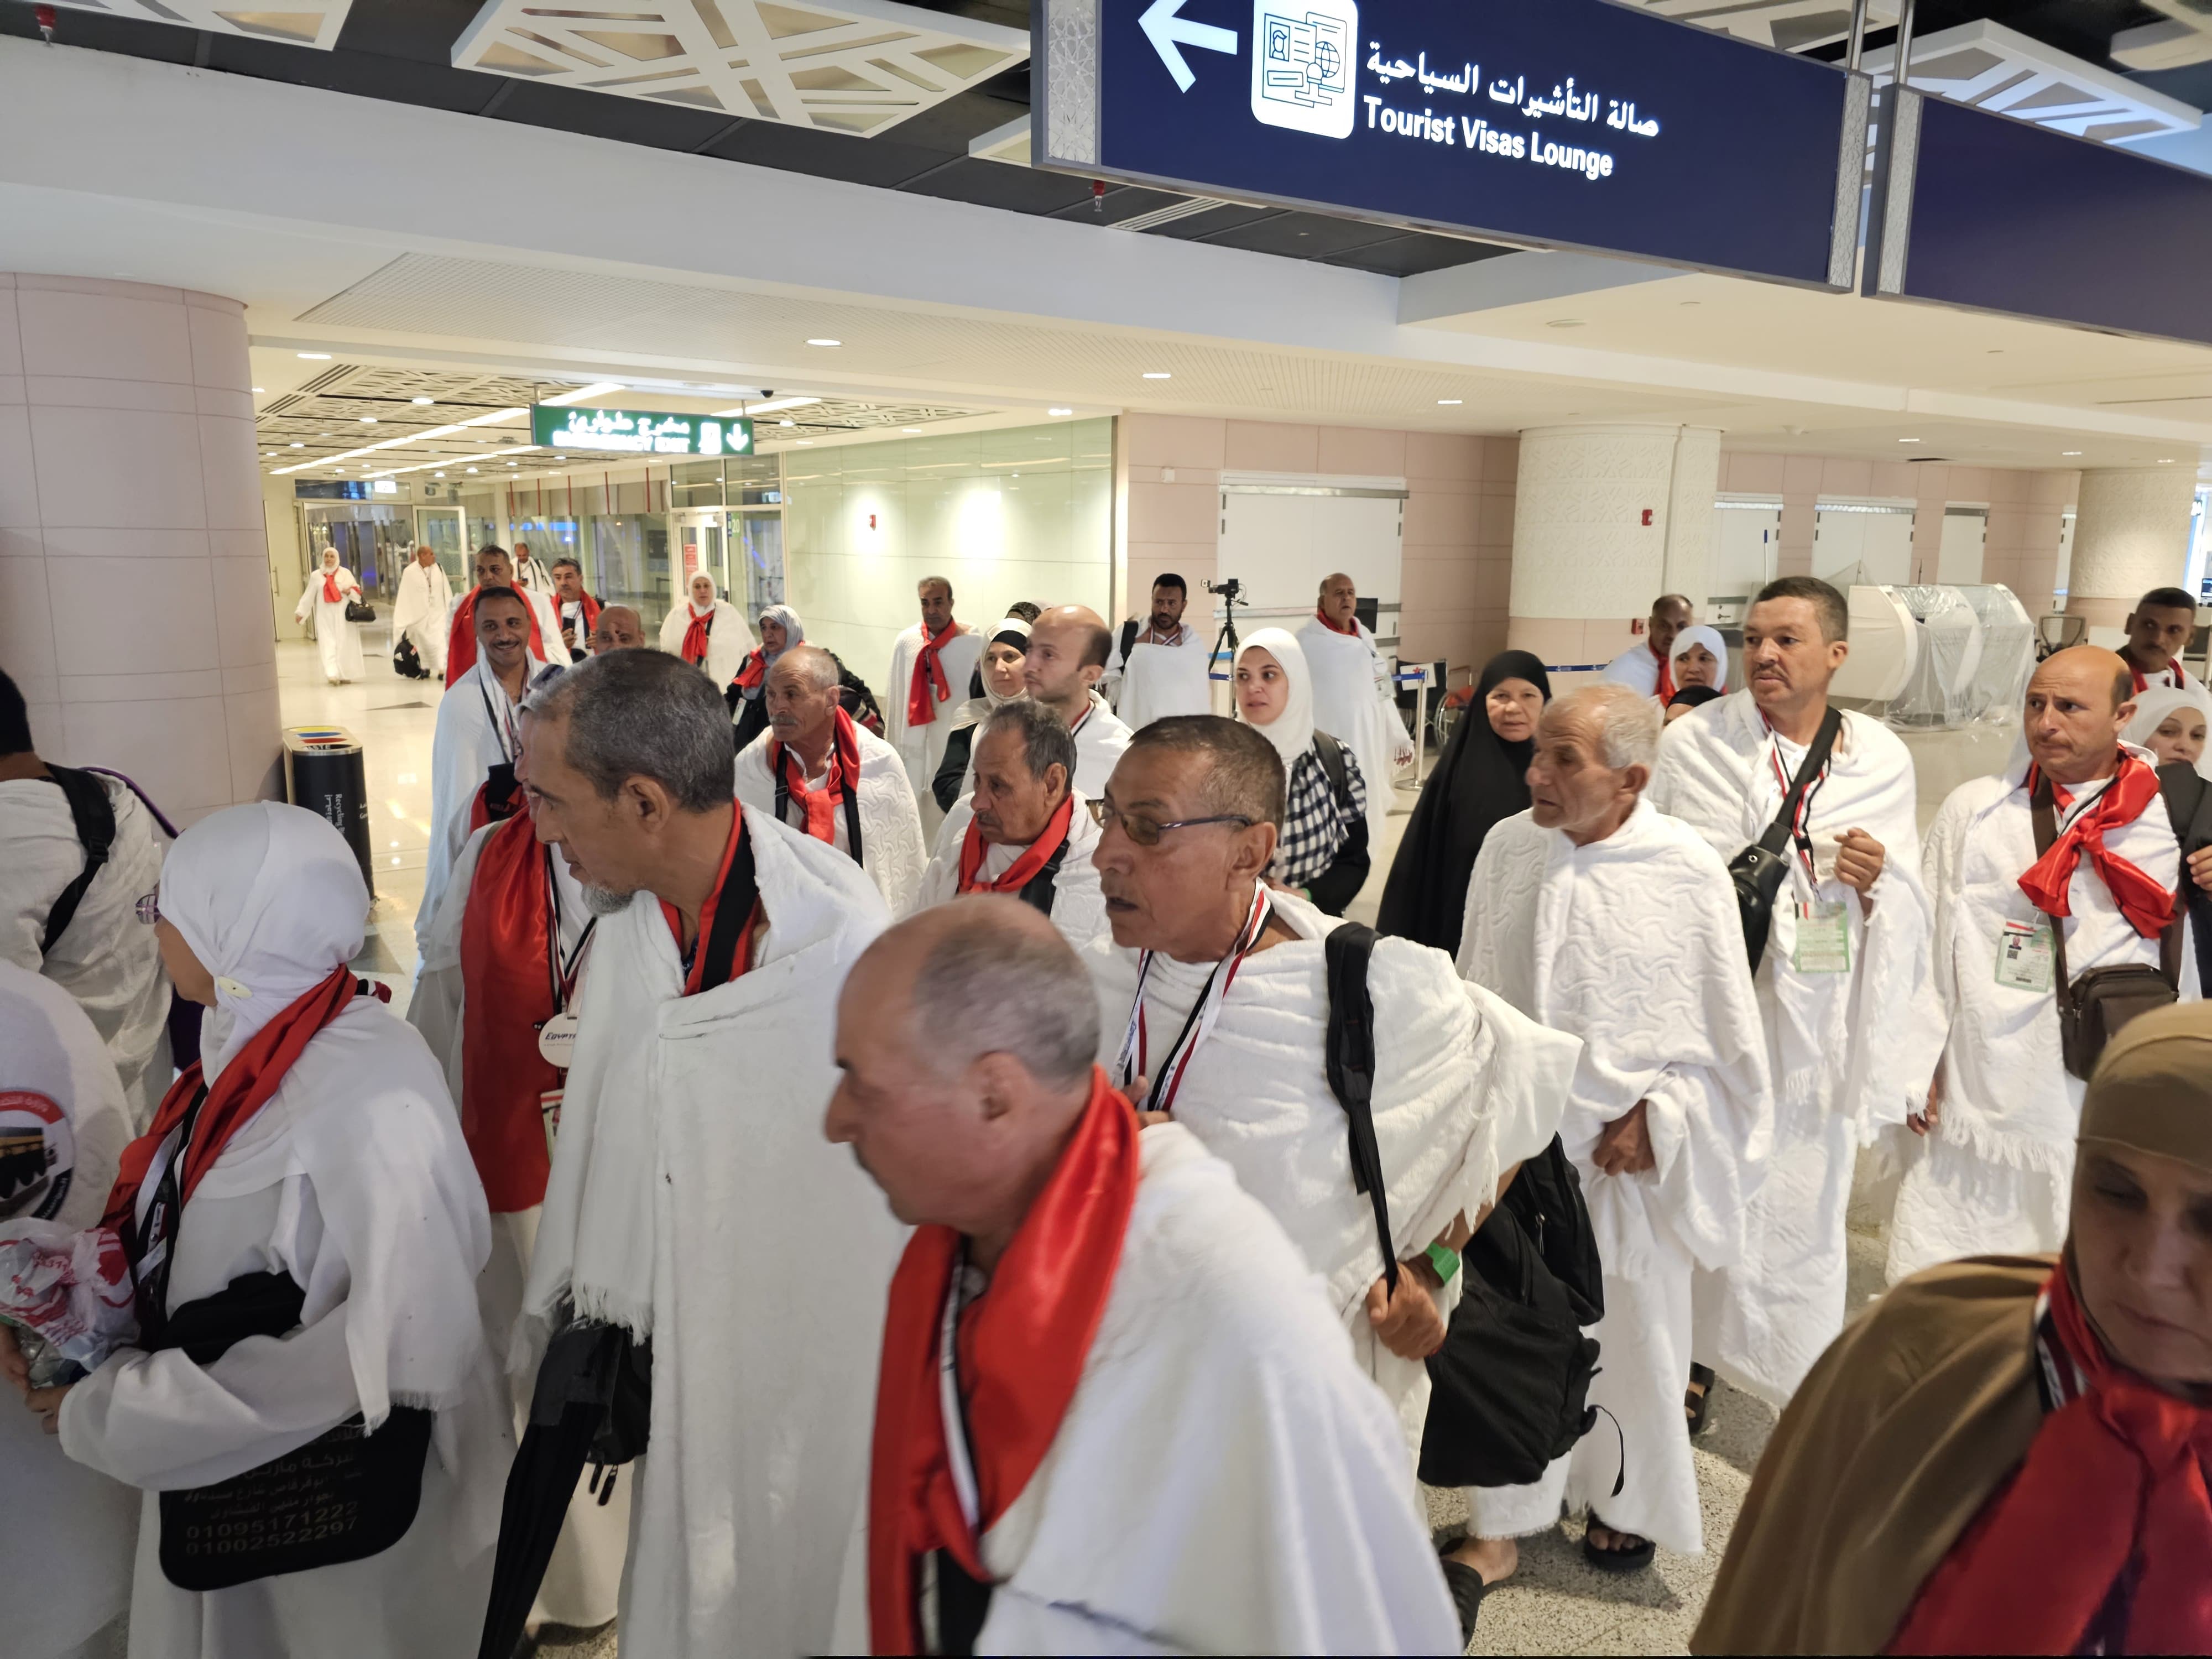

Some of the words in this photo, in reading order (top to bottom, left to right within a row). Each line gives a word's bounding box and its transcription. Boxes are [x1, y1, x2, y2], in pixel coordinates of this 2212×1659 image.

[1366, 41, 1479, 95] السياحية
[1489, 75, 1599, 122] التأشيرات
[1606, 99, 1659, 137] صالة
[1363, 95, 1455, 145] Tourist
[1461, 116, 1525, 159] Visas
[1530, 131, 1613, 180] Lounge
[334, 794, 345, 826] Recycling
[186, 1501, 358, 1538] 01095171222
[186, 1516, 358, 1556] 01002522297
